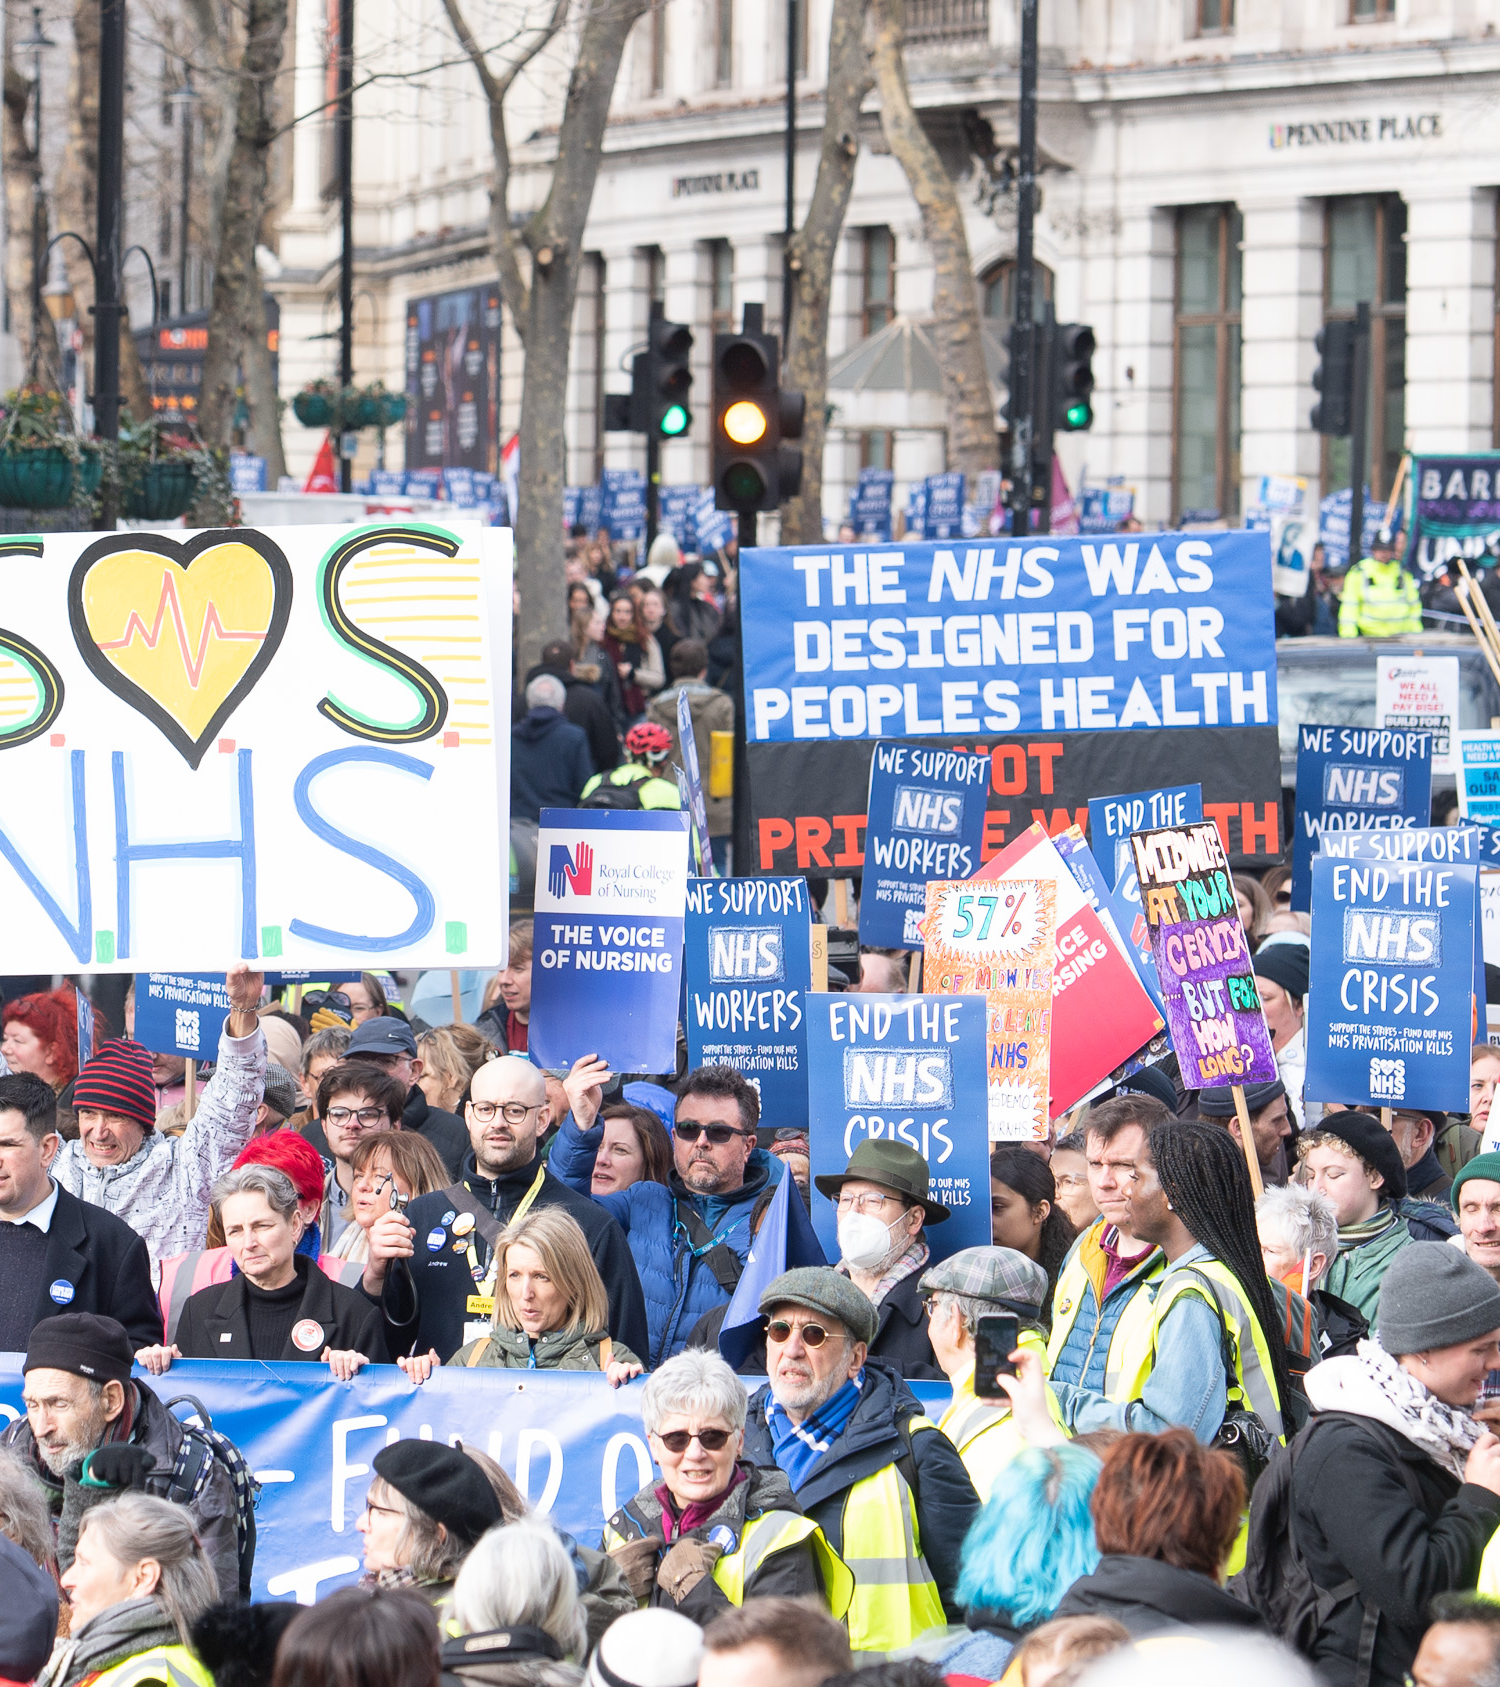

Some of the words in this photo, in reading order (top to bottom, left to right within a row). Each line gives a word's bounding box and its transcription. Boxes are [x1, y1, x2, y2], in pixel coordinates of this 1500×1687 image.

[1286, 119, 1372, 147] PENNINE
[1379, 113, 1444, 141] PLACE
[1421, 468, 1500, 500] BAR
[793, 551, 907, 607] THE
[927, 546, 1060, 603] NHS
[1080, 540, 1214, 597] WAS
[793, 610, 1095, 673] DESIGNED
[1112, 606, 1225, 663] FOR
[753, 679, 1021, 740] PEOPLES
[1040, 670, 1269, 730] HEALTH
[1385, 716, 1418, 727] BUILD
[1420, 717, 1441, 727] FOR
[1302, 727, 1335, 754] WE
[1340, 729, 1431, 761] SUPPORT
[879, 747, 908, 774] WE
[911, 750, 991, 785] SUPPORT
[953, 742, 1064, 797] OT
[1326, 769, 1400, 805] NHS
[896, 791, 961, 832] NHS
[1104, 803, 1146, 836] END
[1149, 791, 1188, 828] THE
[874, 836, 973, 878] WORKERS
[1132, 825, 1226, 884] MIDWIFE
[1371, 827, 1478, 862] SUPPORT
[599, 864, 631, 881] Royal
[633, 864, 676, 883] College
[1332, 865, 1390, 904] END
[1398, 867, 1453, 908] THE
[598, 884, 611, 898] of
[613, 884, 657, 904] Nursing
[687, 883, 713, 914] WE
[722, 878, 804, 916] SUPPORT
[1147, 886, 1182, 926] AT
[953, 892, 1027, 941] 57%
[551, 925, 593, 945] THE
[598, 926, 666, 948] VOICE
[712, 933, 779, 978] NHS
[1166, 920, 1248, 977] CERVIX
[1347, 914, 1437, 962] NHS
[540, 949, 570, 969] OF
[576, 951, 673, 973] NURSING
[941, 974, 964, 993] OF
[975, 966, 1052, 991] MIDWIVES
[1053, 939, 1109, 998] RSING
[695, 989, 802, 1033] WORKERS
[1181, 979, 1225, 1021] BUT
[1227, 975, 1261, 1011] FOR
[1340, 968, 1440, 1017] CRISIS
[830, 1002, 893, 1043] END
[901, 998, 963, 1042] THE
[1005, 1008, 1050, 1034] LEAVE
[1191, 1012, 1237, 1056] HOW
[1329, 1022, 1359, 1035] SUPPORT
[1359, 1024, 1371, 1035] THE
[1372, 1025, 1397, 1037] STRIKES
[1403, 1027, 1421, 1039] FUND
[1423, 1029, 1437, 1039] OUR
[1438, 1030, 1453, 1040] NHS
[775, 1056, 799, 1071] KILLS
[991, 1041, 1029, 1069] NHS
[1198, 1042, 1255, 1080] LONG?
[1328, 1034, 1350, 1049] NHS
[1352, 1035, 1424, 1054] PRIVATISATION
[1426, 1040, 1453, 1056] KILLS
[850, 1055, 946, 1103] NHS
[1369, 1074, 1406, 1095] NHS
[941, 1190, 972, 1206] KILLS
